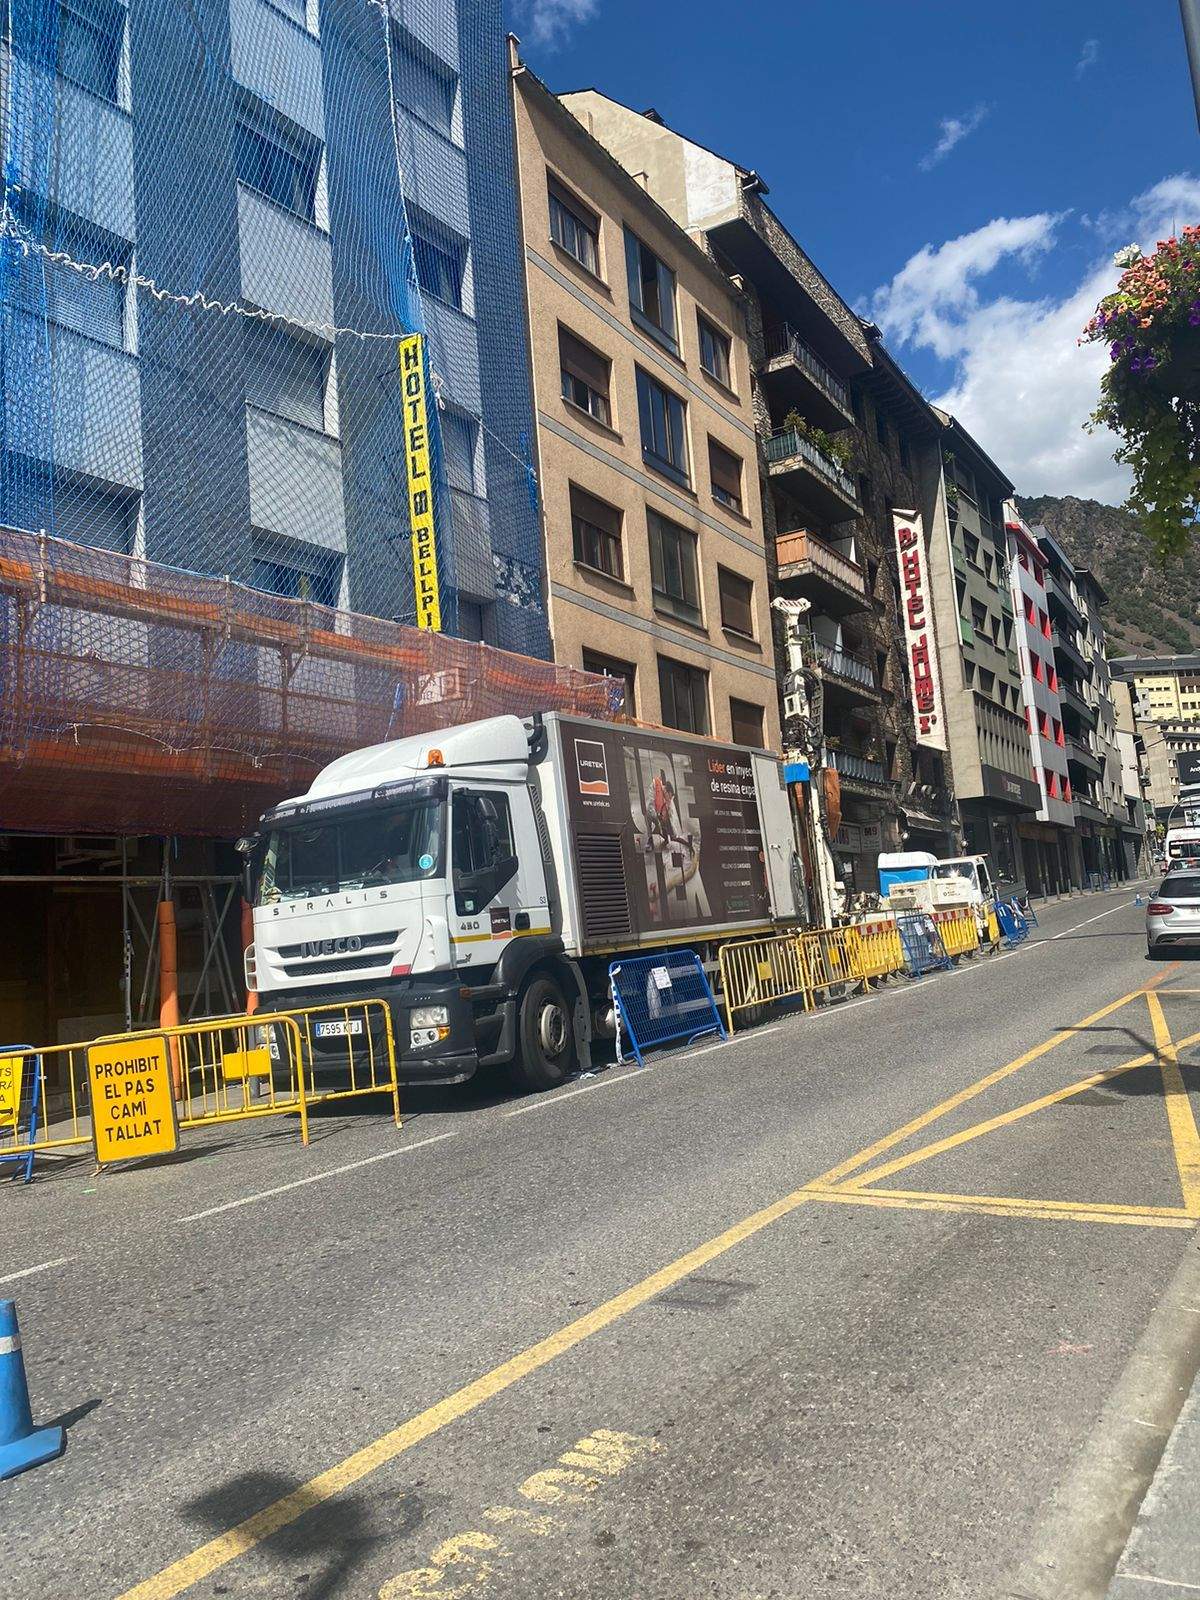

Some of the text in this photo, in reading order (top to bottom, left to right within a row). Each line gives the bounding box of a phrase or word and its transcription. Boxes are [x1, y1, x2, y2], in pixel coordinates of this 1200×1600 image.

[404, 344, 426, 480] HOTEL
[902, 550, 925, 630] HOTEL
[912, 633, 935, 714] JAUME
[580, 760, 604, 770] URETEK
[726, 764, 735, 775] en
[710, 779, 720, 792] de
[273, 890, 389, 916] STRALIS
[300, 936, 362, 958] IVECO
[321, 1023, 341, 1035] 7595
[95, 1056, 160, 1079] PROHIBIT
[105, 1079, 155, 1100] EL PAS
[111, 1098, 147, 1119] CAMÍ
[105, 1120, 162, 1142] TALLAT
